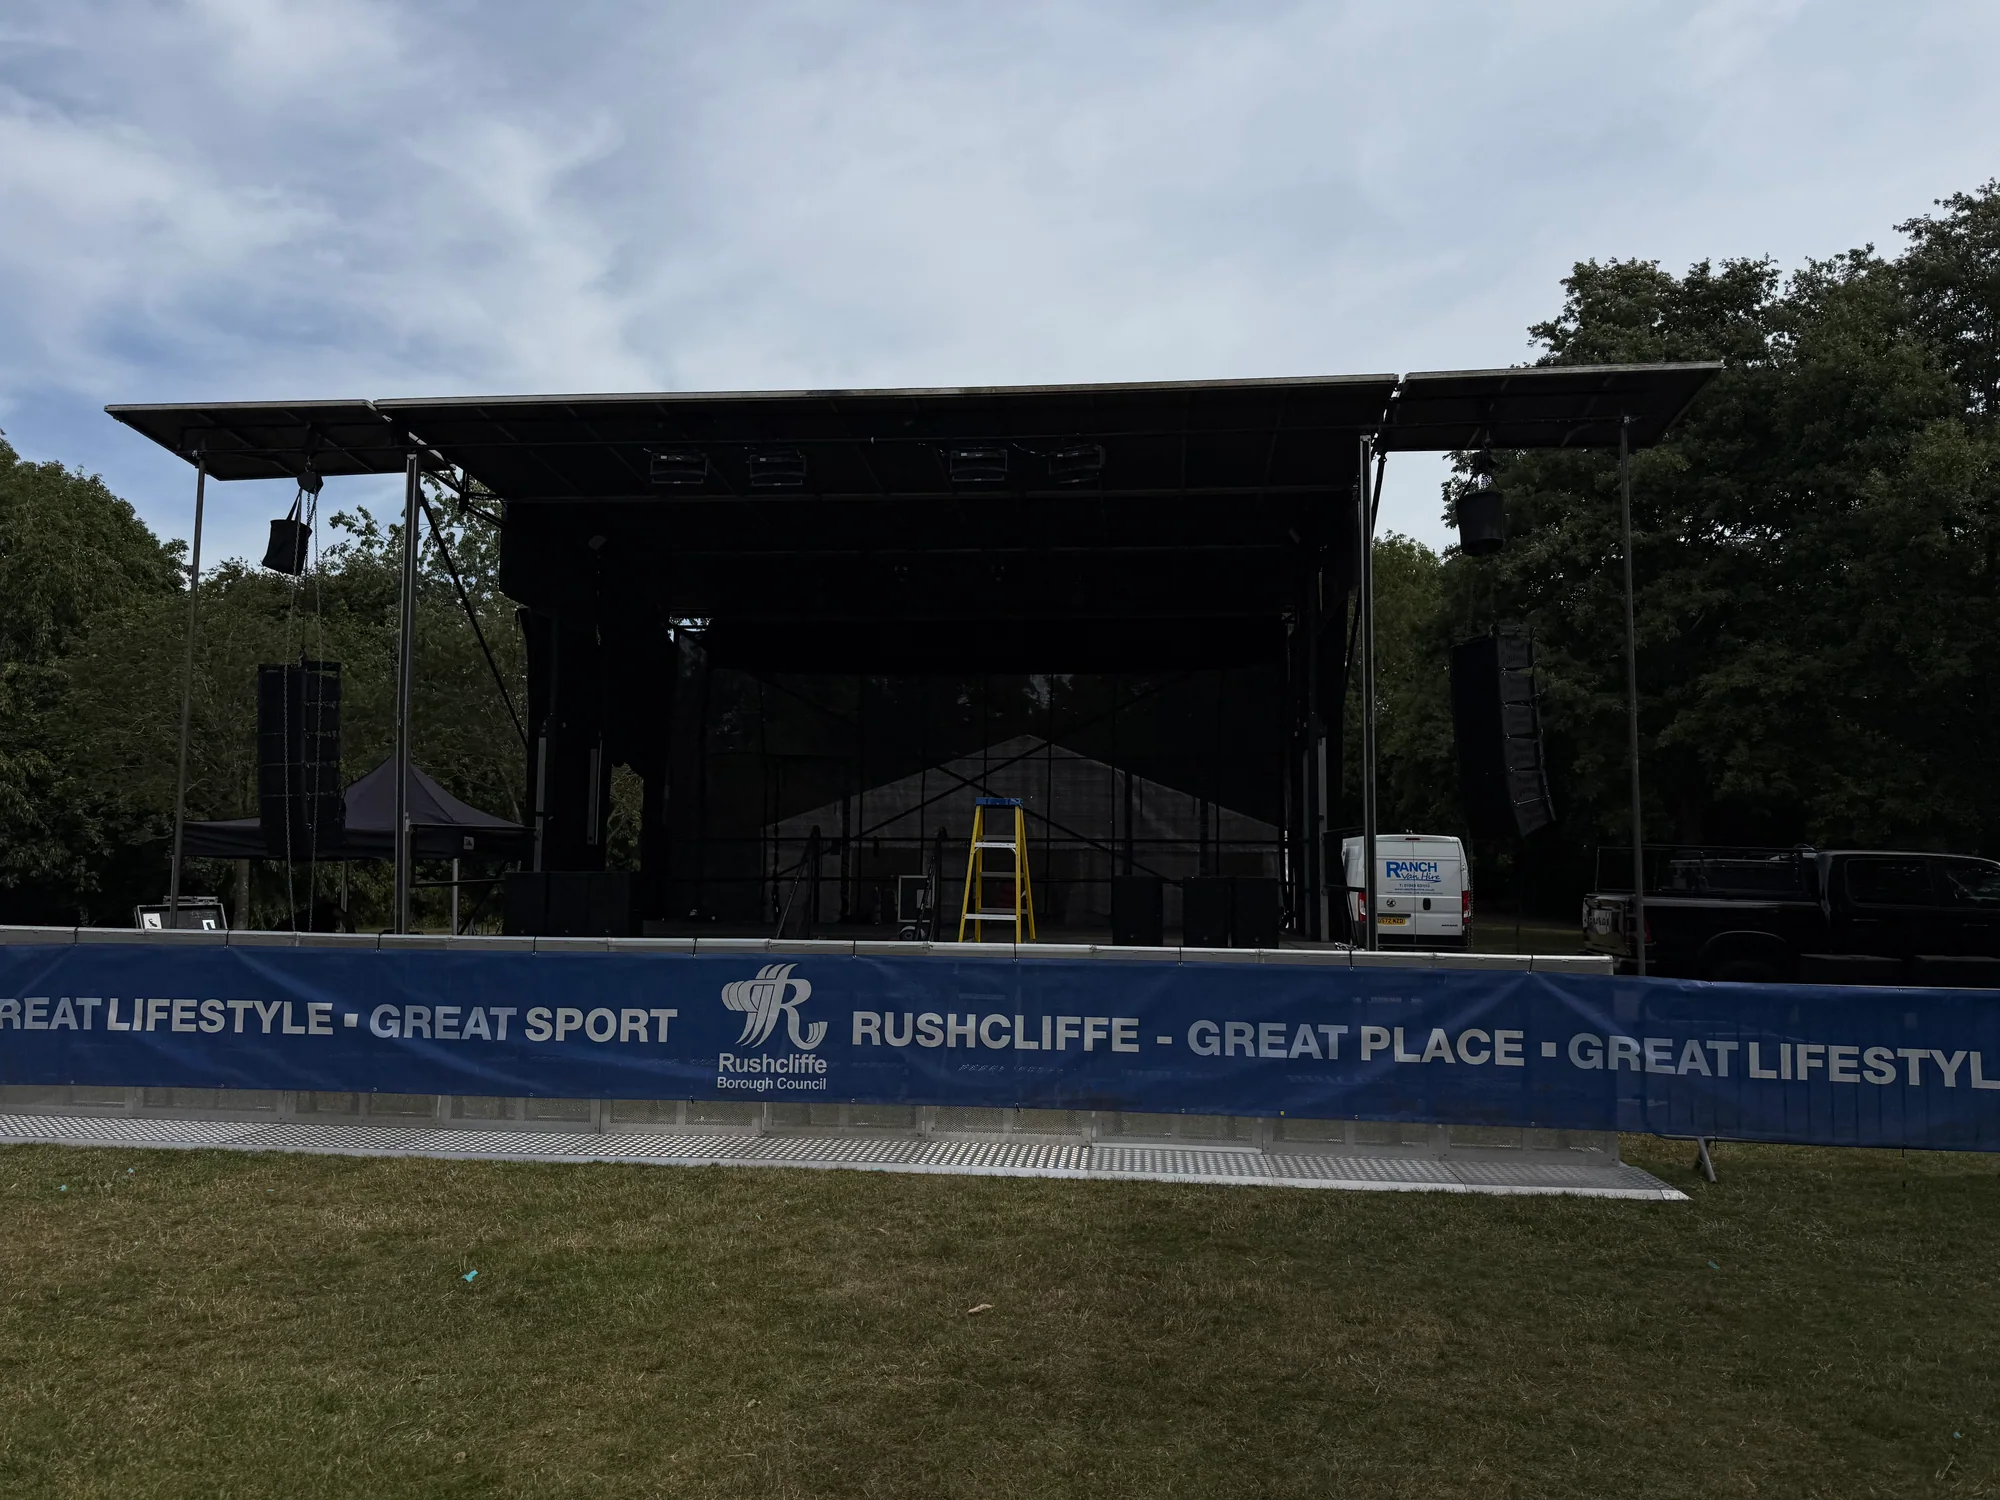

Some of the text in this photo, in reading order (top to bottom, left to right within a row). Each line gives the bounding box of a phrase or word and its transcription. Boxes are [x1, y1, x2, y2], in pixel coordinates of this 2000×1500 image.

[1386, 861, 1437, 878] RANCH
[1421, 872, 1440, 880] Hire
[107, 998, 334, 1036] LIFESTYLE
[369, 1003, 518, 1041] GREAT
[524, 1007, 678, 1043] SPORT
[852, 1010, 1140, 1053] RUSHCLIFFE
[1187, 1020, 1348, 1061] GREAT
[1360, 1025, 1525, 1067] PLACE
[1567, 1032, 1740, 1077] GREAT
[1748, 1042, 2000, 1090] LIFESTYL
[718, 1052, 828, 1074] Rushcliffe
[717, 1076, 827, 1092] Borough Council
